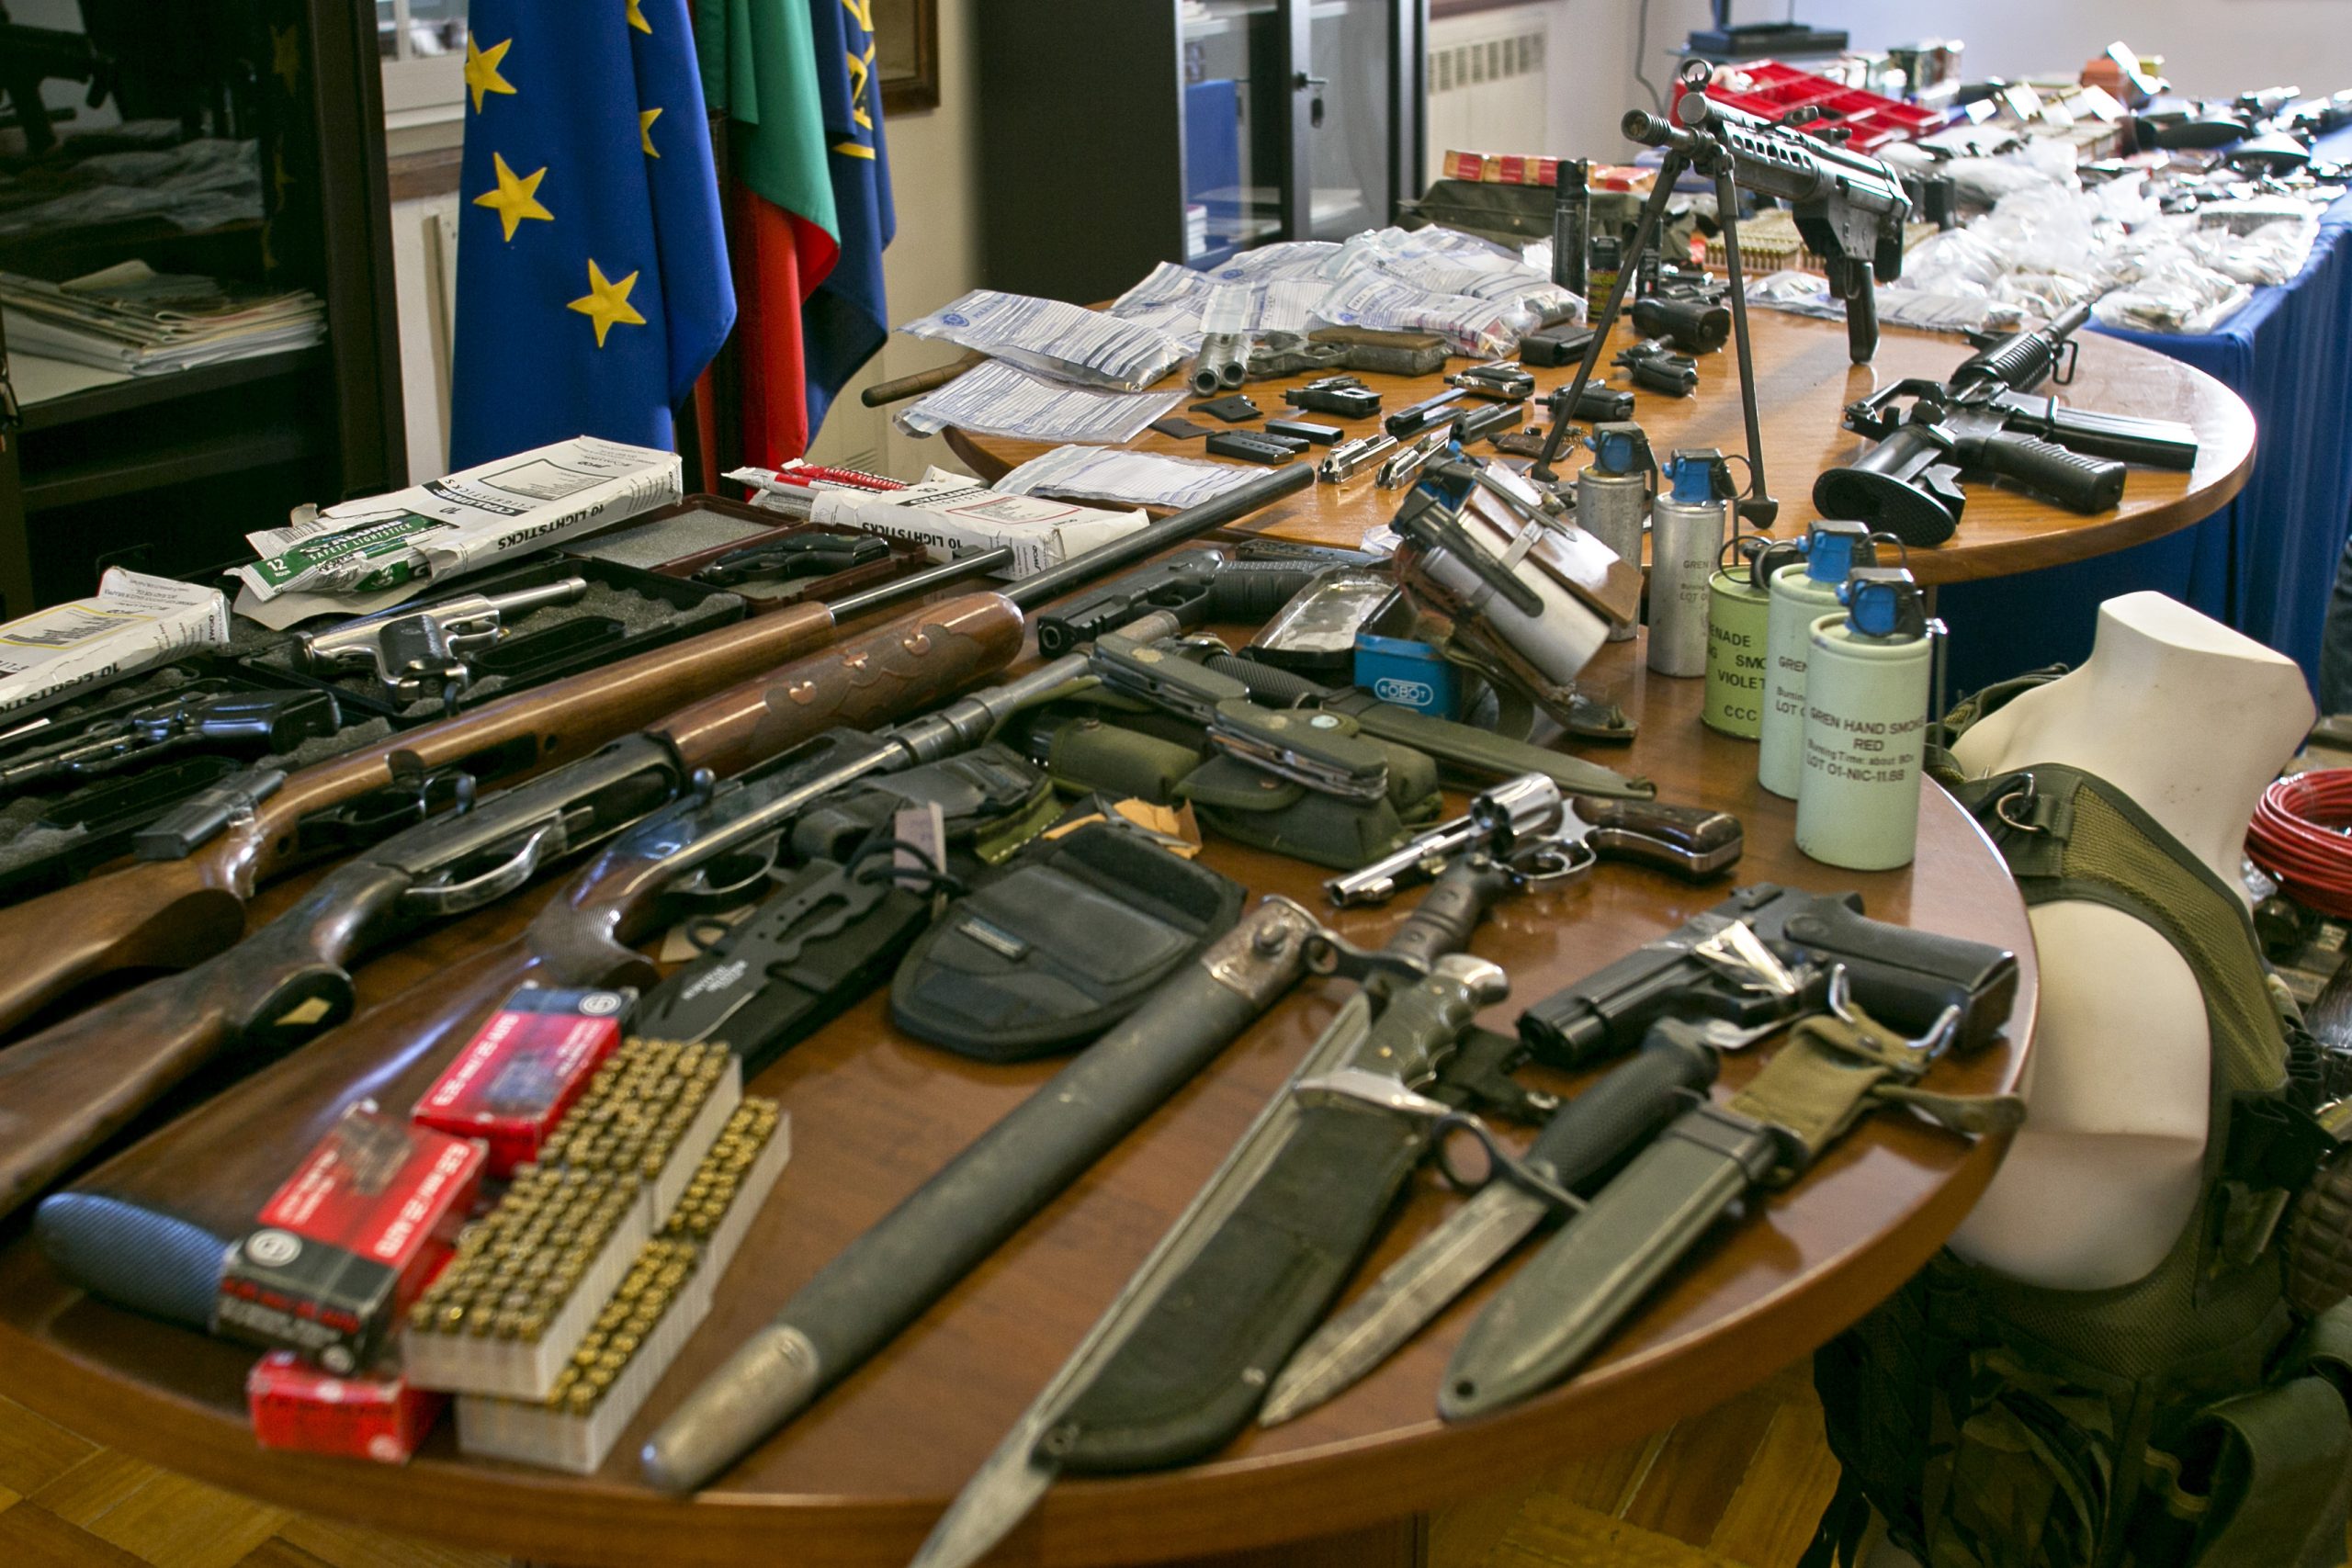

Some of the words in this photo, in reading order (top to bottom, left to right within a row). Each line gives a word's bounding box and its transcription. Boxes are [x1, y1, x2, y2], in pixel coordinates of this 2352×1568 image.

[433, 489, 514, 514] CYALUME
[591, 503, 605, 516] 10
[498, 510, 586, 551] LIGHTSTICKS
[309, 542, 351, 560] SAFETY
[352, 523, 413, 546] LIGHTSTICK
[948, 537, 963, 549] 10
[266, 558, 288, 572] 12
[1683, 560, 1709, 570] GREN
[1708, 624, 1751, 648] ENADE
[100, 661, 120, 678] 10
[1736, 654, 1767, 670] SMO
[1717, 669, 1766, 690] VIOLET
[1380, 684, 1426, 699] ROBOT
[1724, 705, 1757, 721] CCC
[1776, 700, 1798, 715] LOT
[1810, 706, 1840, 728] GREN
[1843, 719, 1885, 735] HAND
[1853, 738, 1884, 751] RED
[1806, 751, 1826, 771] LOT
